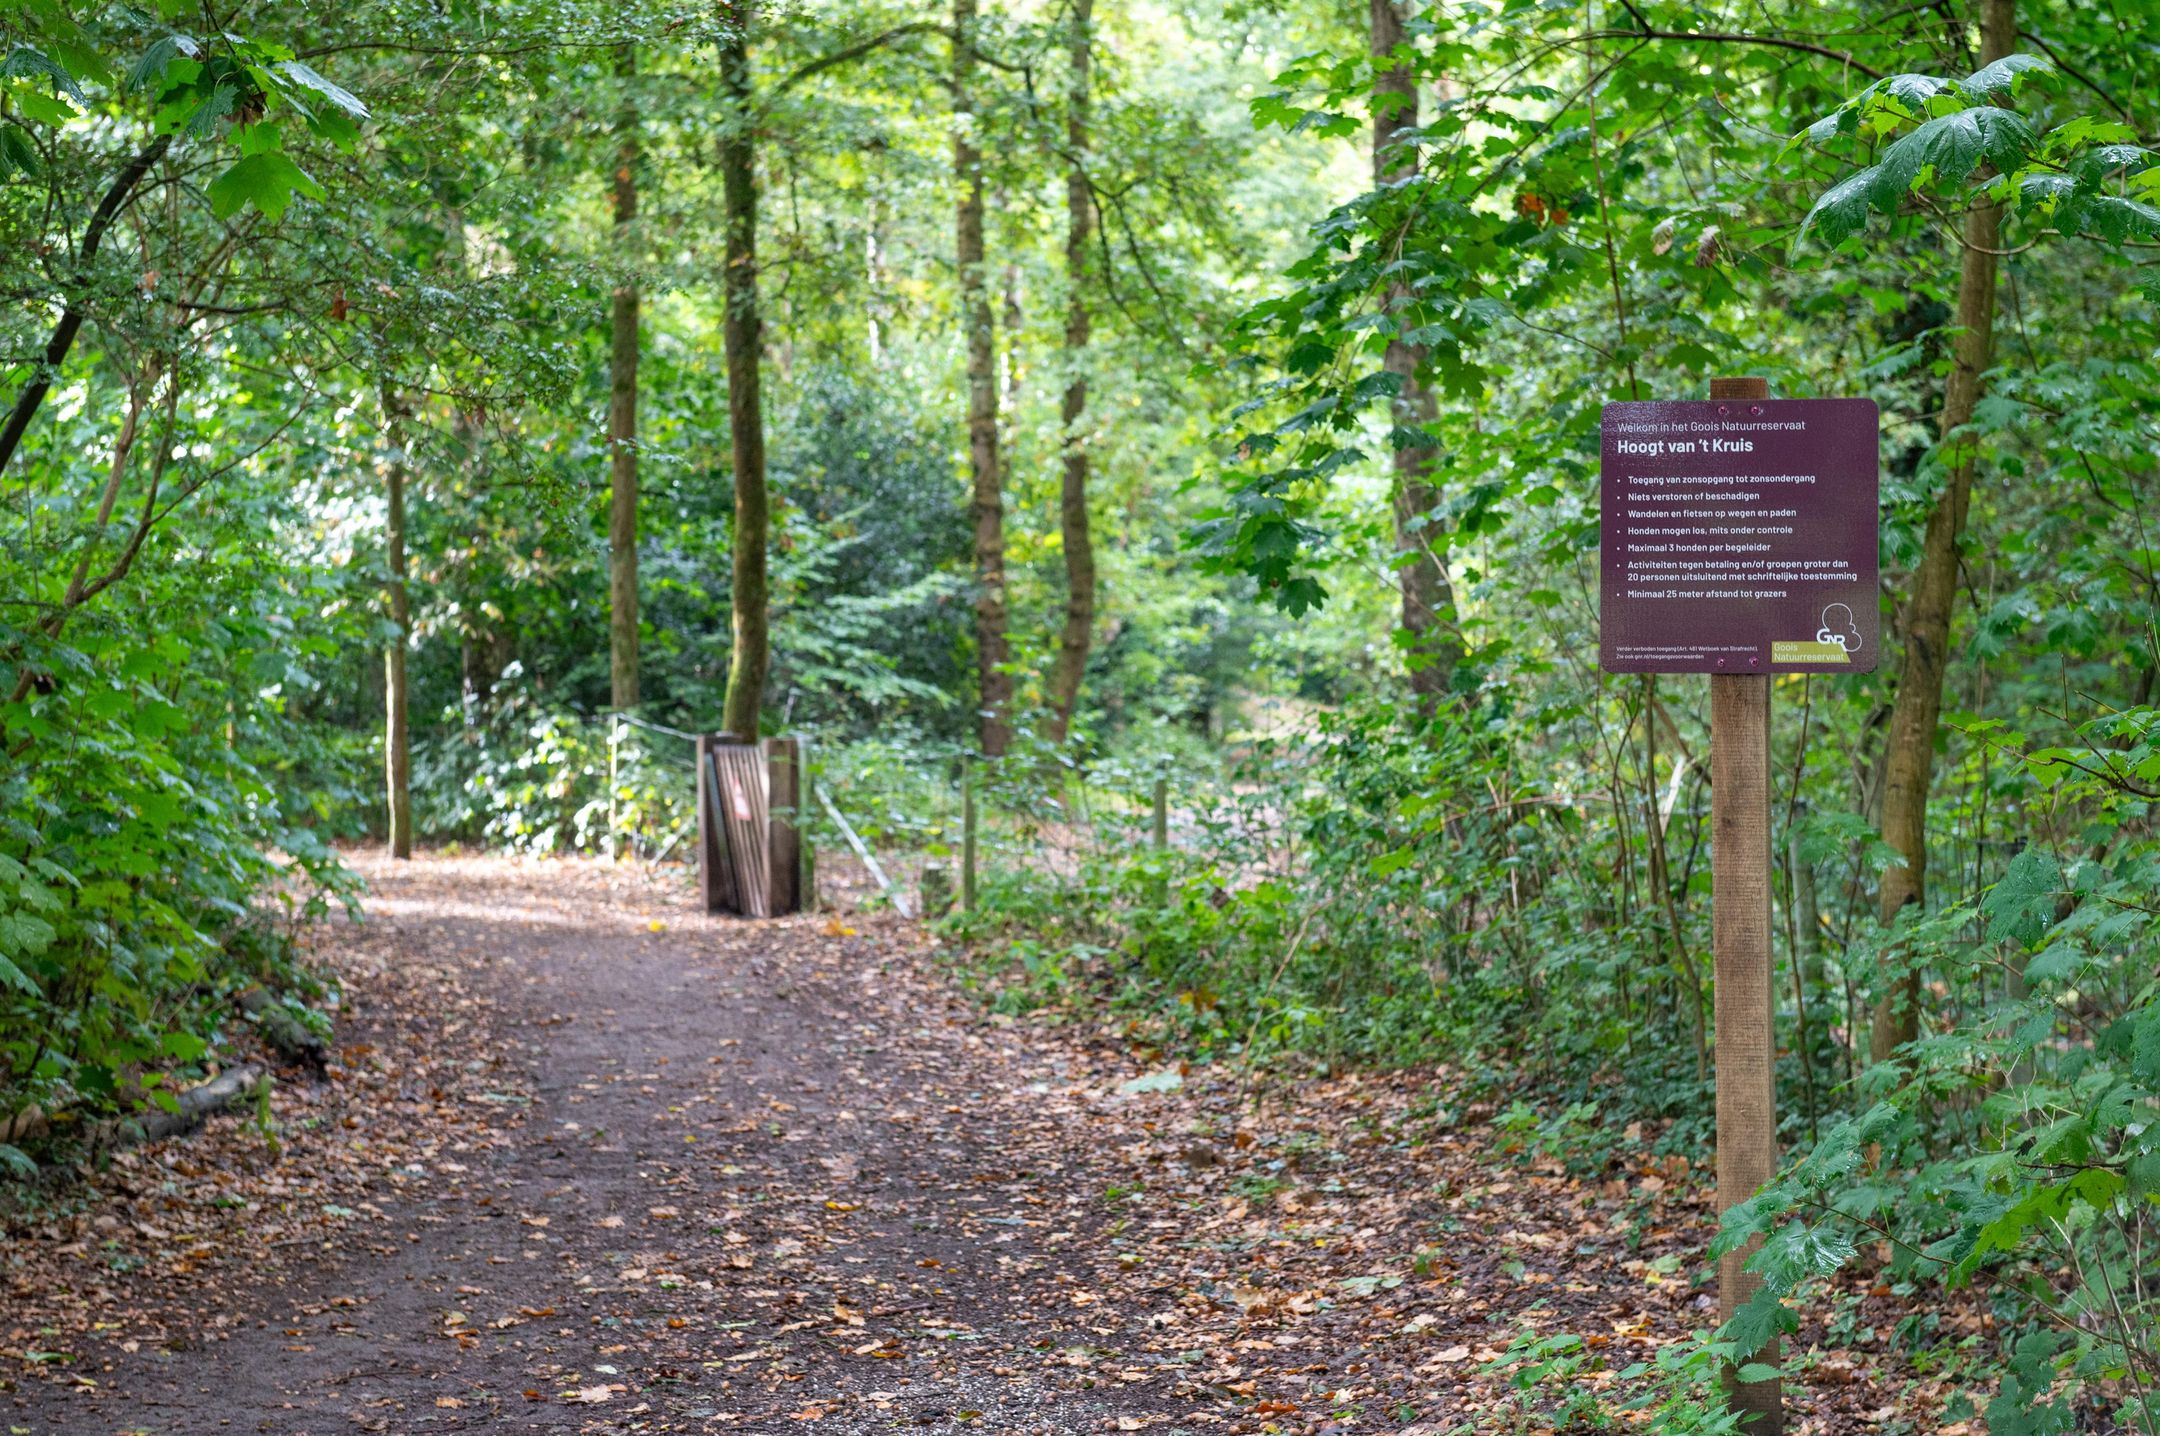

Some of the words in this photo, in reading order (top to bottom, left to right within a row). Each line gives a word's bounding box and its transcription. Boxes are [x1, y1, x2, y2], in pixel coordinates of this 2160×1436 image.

[1617, 422, 1658, 433] Welkom
[1660, 421, 1669, 432] in
[1671, 421, 1688, 432] het
[1690, 421, 1720, 432] Goois
[1721, 420, 1806, 431] Natuurreservaat
[1617, 439, 1665, 456] Hoogt
[1668, 442, 1695, 453] van
[1712, 438, 1754, 452] Kruis
[1628, 475, 1664, 486] Toegang
[1682, 475, 1734, 485] zonsopgang
[1735, 475, 1748, 483] tot
[1749, 474, 1816, 485] zonsondergang
[1628, 492, 1650, 501] Niets
[1651, 493, 1693, 501] verstoren
[1694, 492, 1704, 501] of
[1705, 491, 1760, 502] beschadigen
[1628, 509, 1669, 518] Wandelen
[1683, 509, 1713, 518] fietsen
[1715, 510, 1726, 519] op
[1727, 510, 1756, 519] wegen
[1769, 509, 1797, 519] paden
[1627, 527, 1661, 535] Honden
[1662, 528, 1691, 536] mogen
[1692, 526, 1708, 536] los,
[1709, 526, 1729, 534] mits
[1730, 526, 1756, 534] onder
[1757, 526, 1793, 534] controle
[1627, 543, 1668, 552] Maximaal
[1668, 543, 1674, 552] 3
[1675, 543, 1708, 552] honden
[1709, 544, 1724, 553] per
[1725, 542, 1771, 553] begeleider
[1627, 560, 1678, 569] Activiteiten
[1678, 561, 1704, 571] tegen
[1705, 560, 1740, 570] betaling
[1741, 559, 1765, 569] en/of
[1766, 561, 1802, 570] groepen
[1803, 561, 1831, 570] groter
[1832, 559, 1849, 568] dan
[1627, 573, 1639, 582] 20
[1640, 574, 1680, 583] personen
[1681, 572, 1727, 581] uitsluitend
[1728, 573, 1746, 581] met
[1747, 572, 1799, 582] schriftelijke
[1800, 571, 1858, 582] toestemming
[1627, 590, 1665, 598] Minimaal
[1666, 590, 1677, 598] 25
[1678, 590, 1704, 598] meter
[1705, 589, 1739, 598] afstand
[1740, 590, 1753, 598] tot
[1754, 591, 1787, 599] grazers
[1774, 642, 1798, 652] Goois
[1774, 652, 1844, 661] Natuurreservaat
